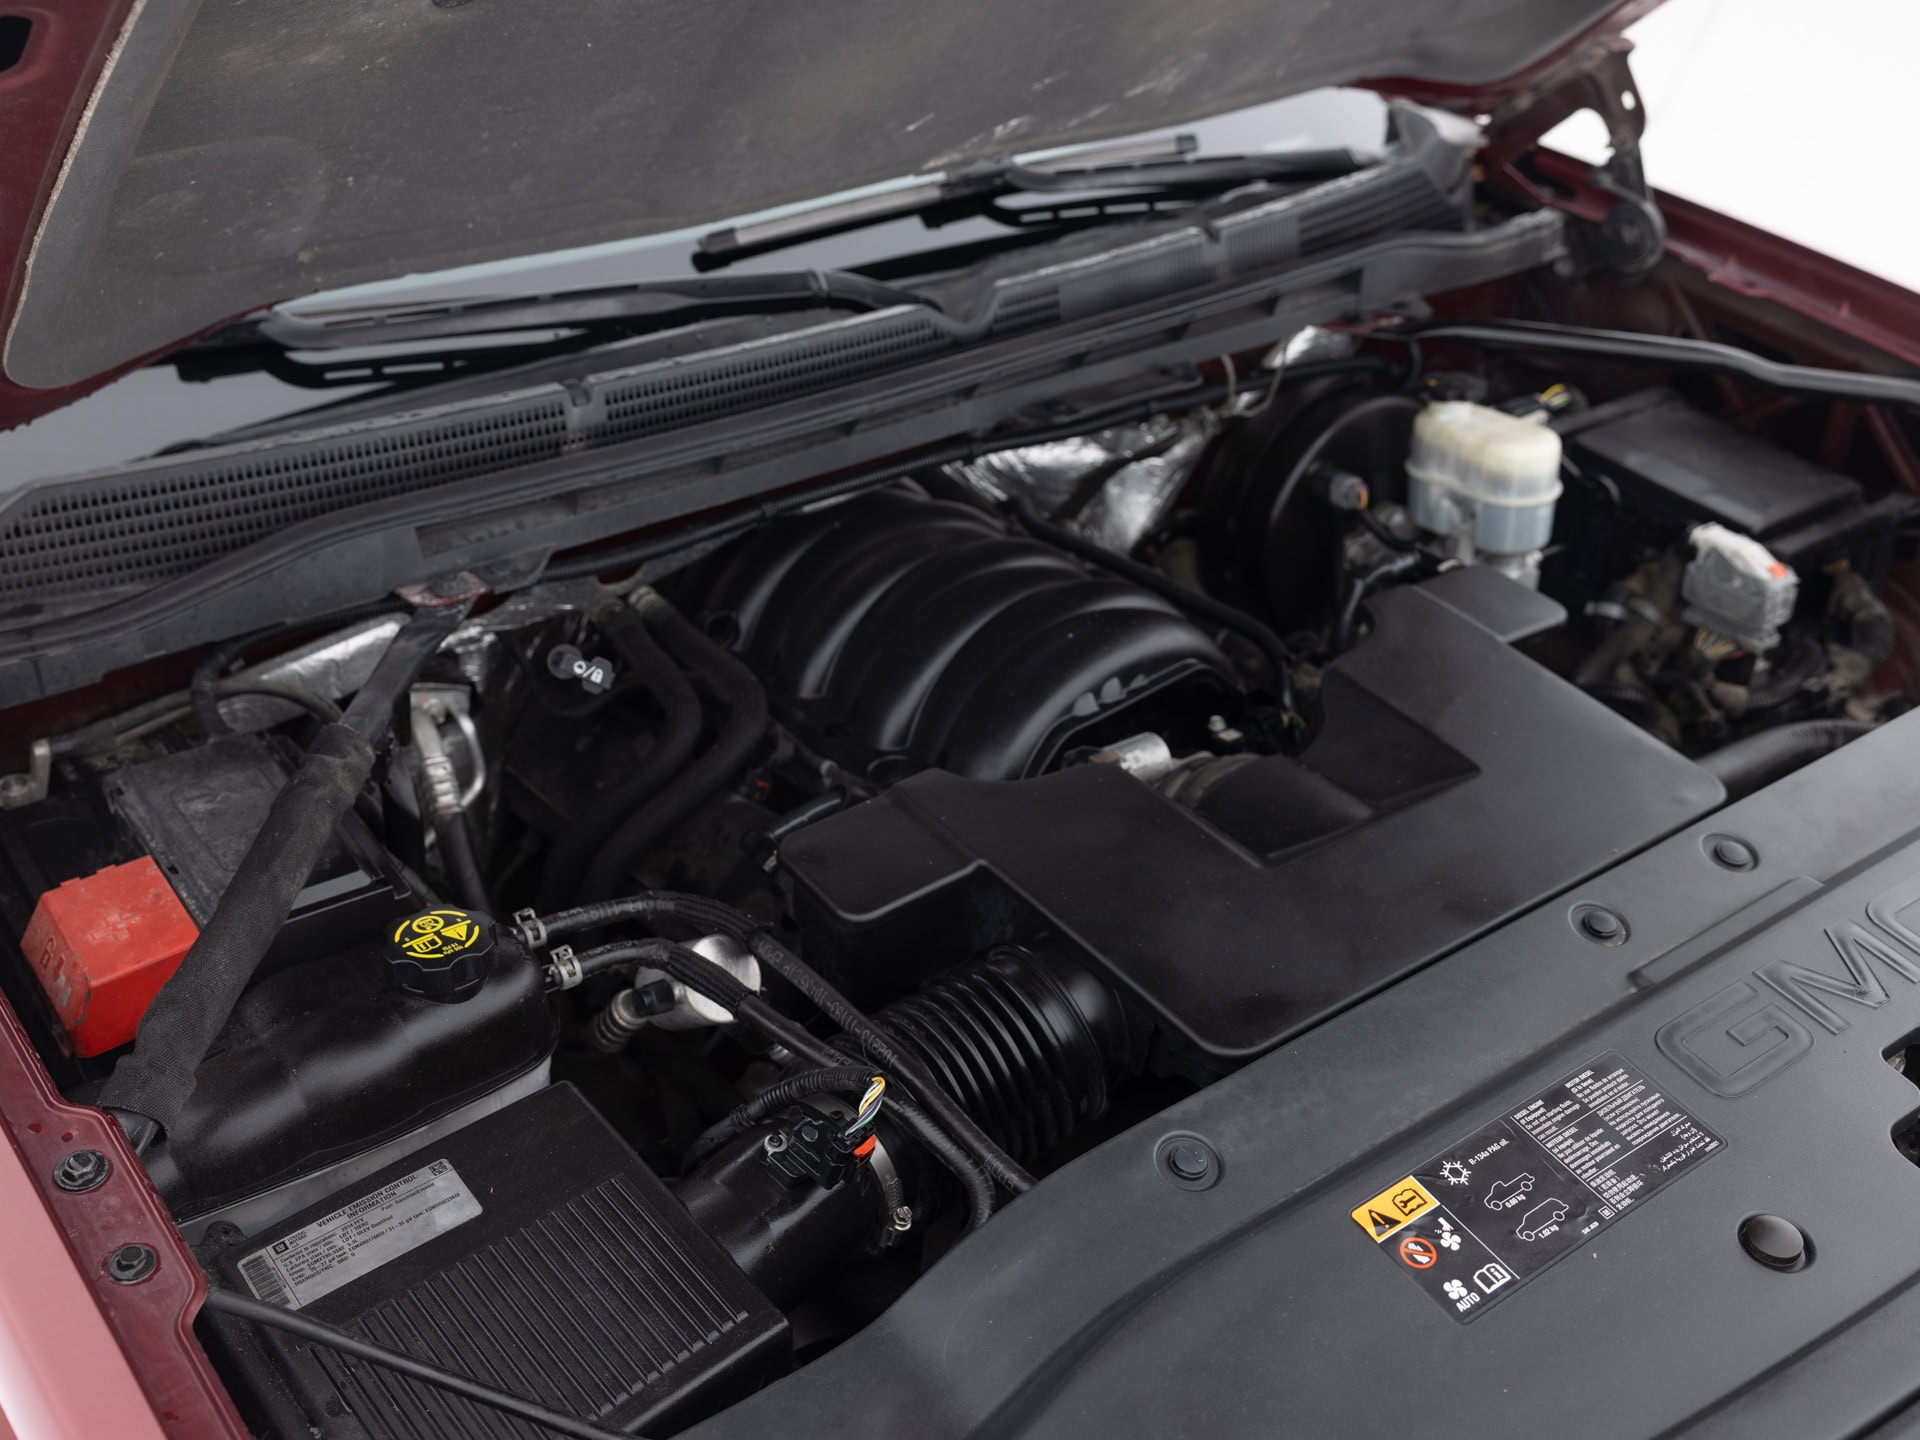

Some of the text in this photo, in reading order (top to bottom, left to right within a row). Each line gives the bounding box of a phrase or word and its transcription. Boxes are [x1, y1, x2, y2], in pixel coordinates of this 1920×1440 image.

[1468, 1151, 1490, 1165] R-134a
[1487, 1143, 1501, 1153] PAG
[317, 1175, 417, 1227] VEHICLE EMISSION CONTROL
[347, 1191, 396, 1218] INFORMATION
[342, 1235, 352, 1243] LDT
[1548, 1224, 1559, 1232] kg
[295, 1254, 306, 1262] EPA
[339, 1231, 349, 1239] LDT
[1456, 1292, 1480, 1312] AUTO
